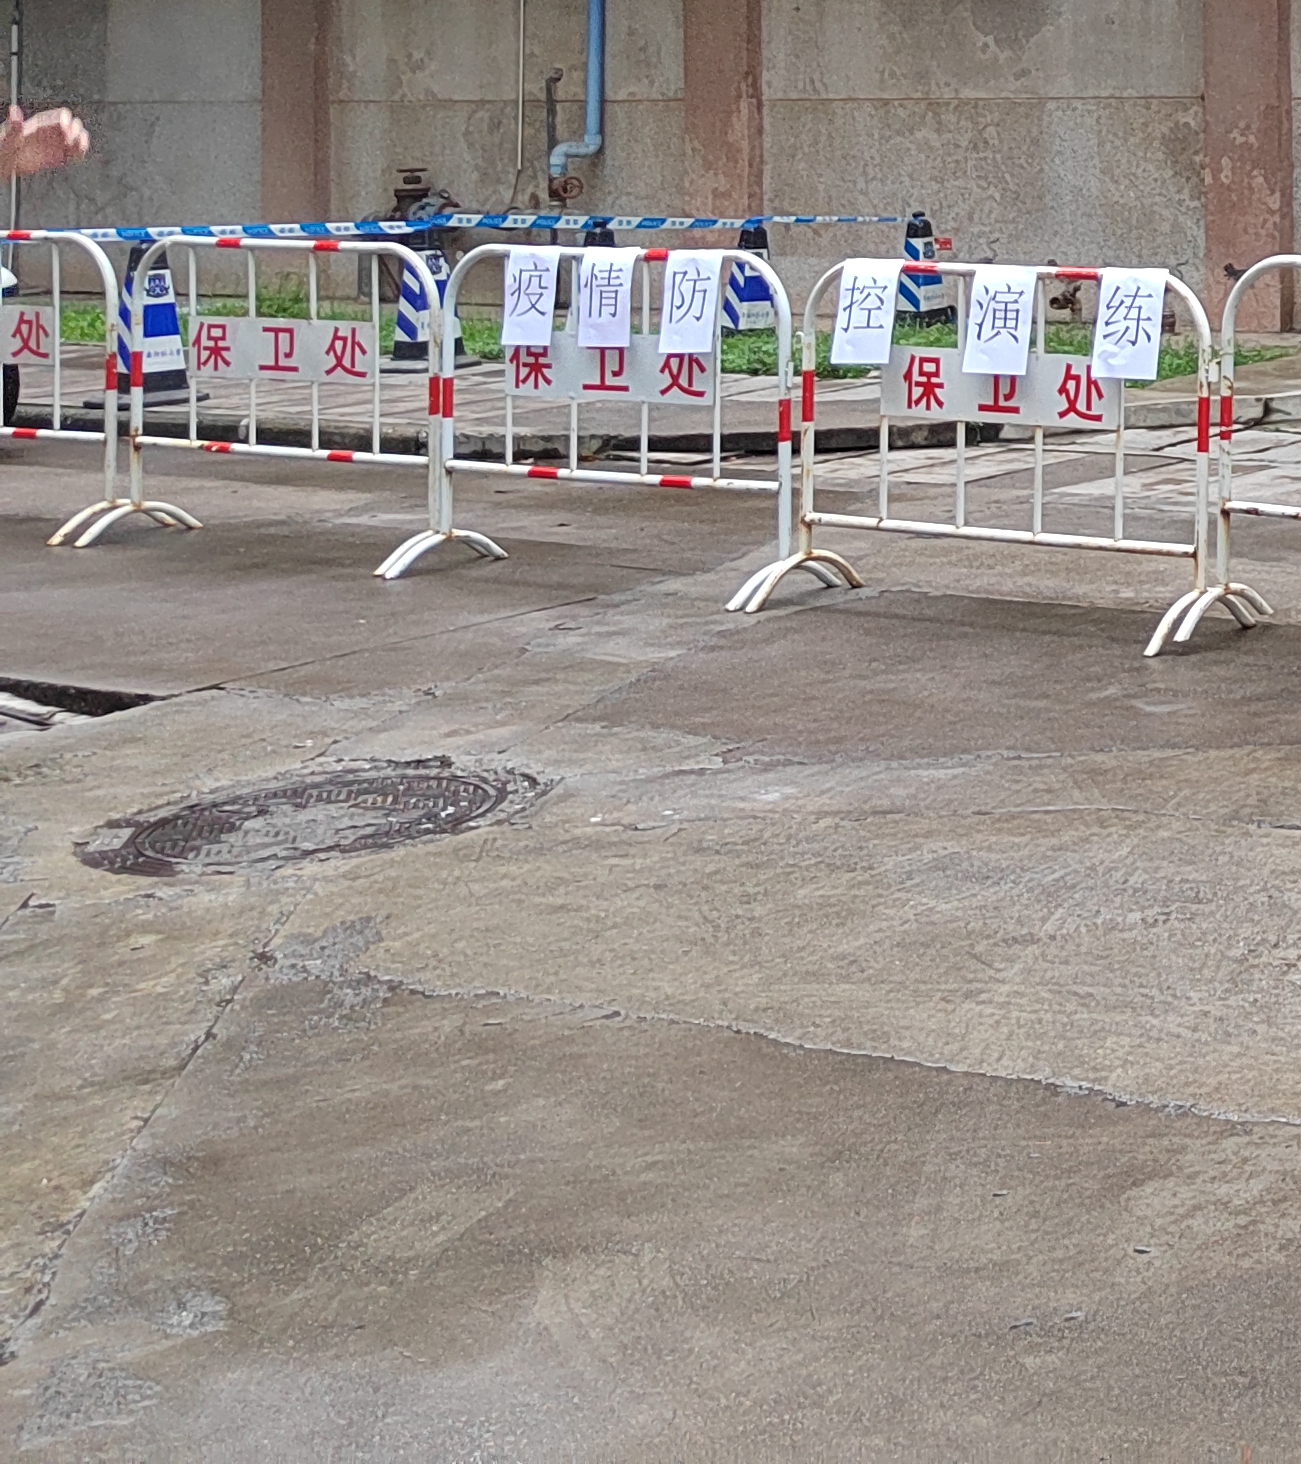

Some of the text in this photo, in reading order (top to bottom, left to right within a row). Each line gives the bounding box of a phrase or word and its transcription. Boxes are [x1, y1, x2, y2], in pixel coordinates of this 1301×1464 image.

[10, 310, 51, 360] 处
[191, 320, 368, 378] 保卫处
[509, 344, 707, 397] 保卫处
[902, 353, 1105, 423] 保卫处
